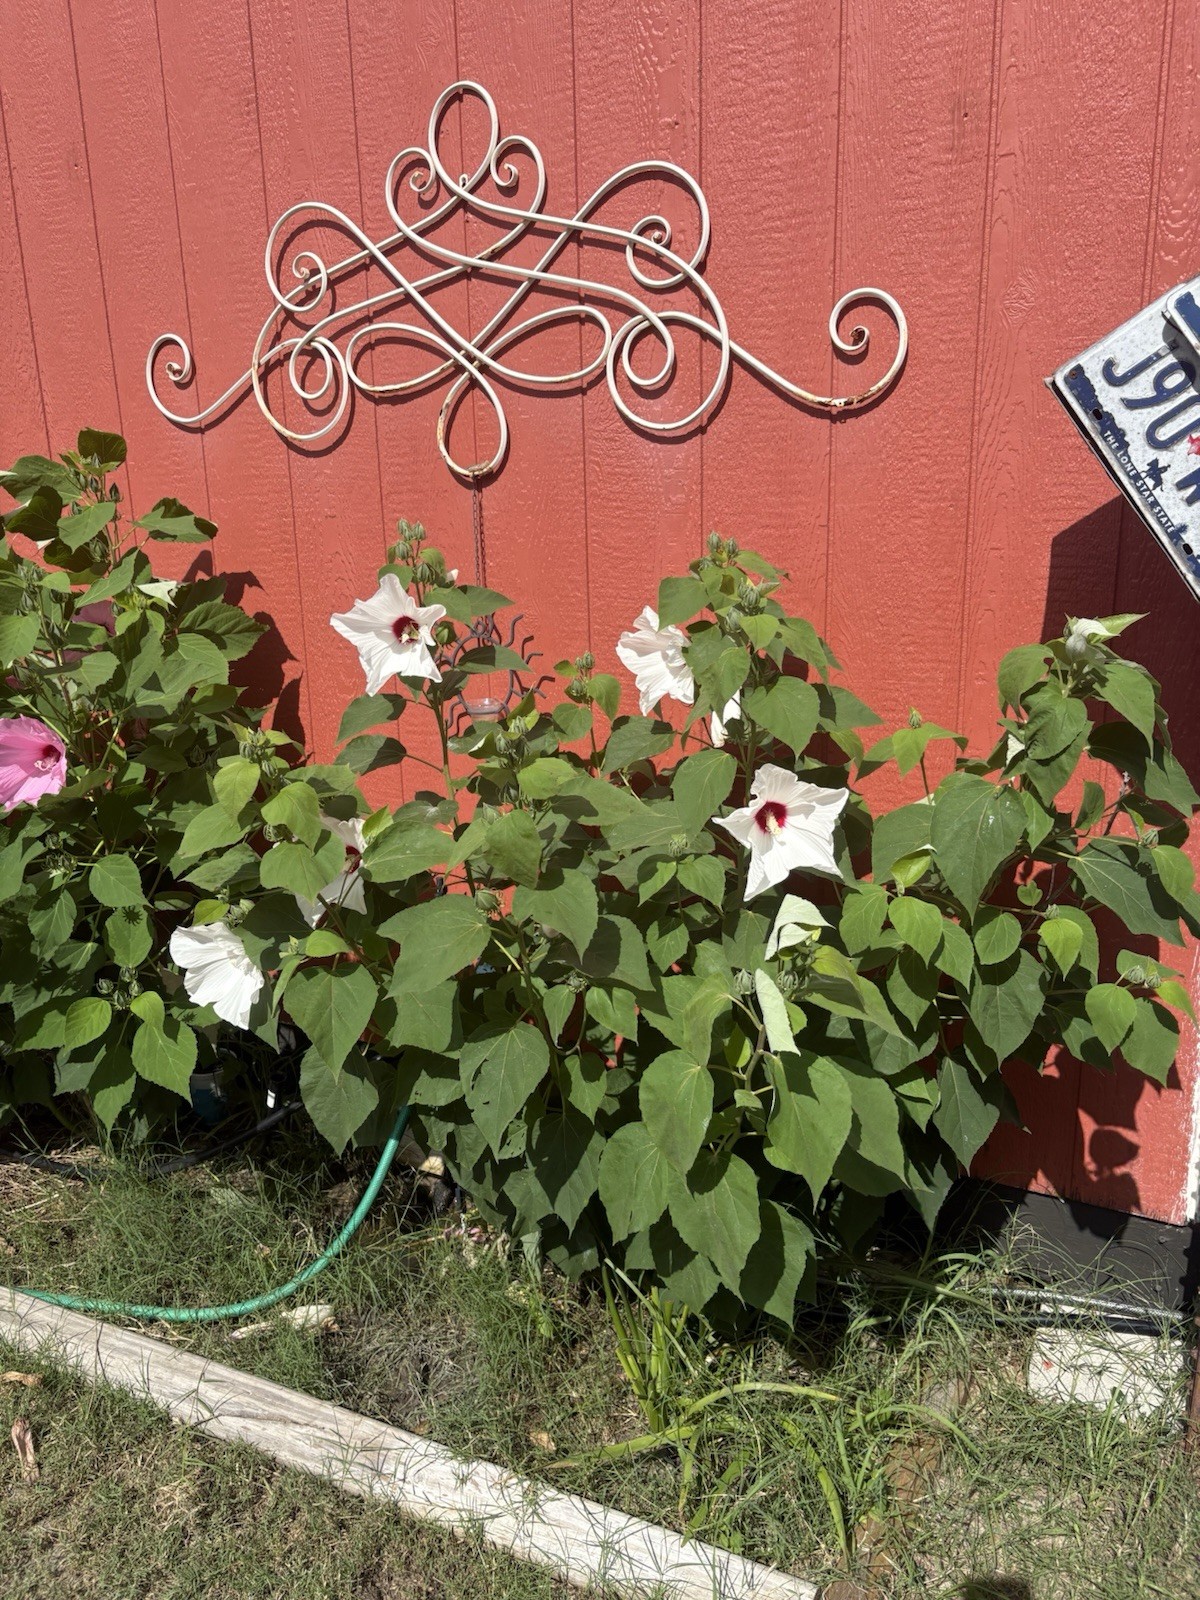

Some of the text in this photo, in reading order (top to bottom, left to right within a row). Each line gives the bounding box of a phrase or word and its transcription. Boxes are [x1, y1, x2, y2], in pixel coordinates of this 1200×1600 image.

[1103, 430, 1175, 534] THE LONE STAR STATE
